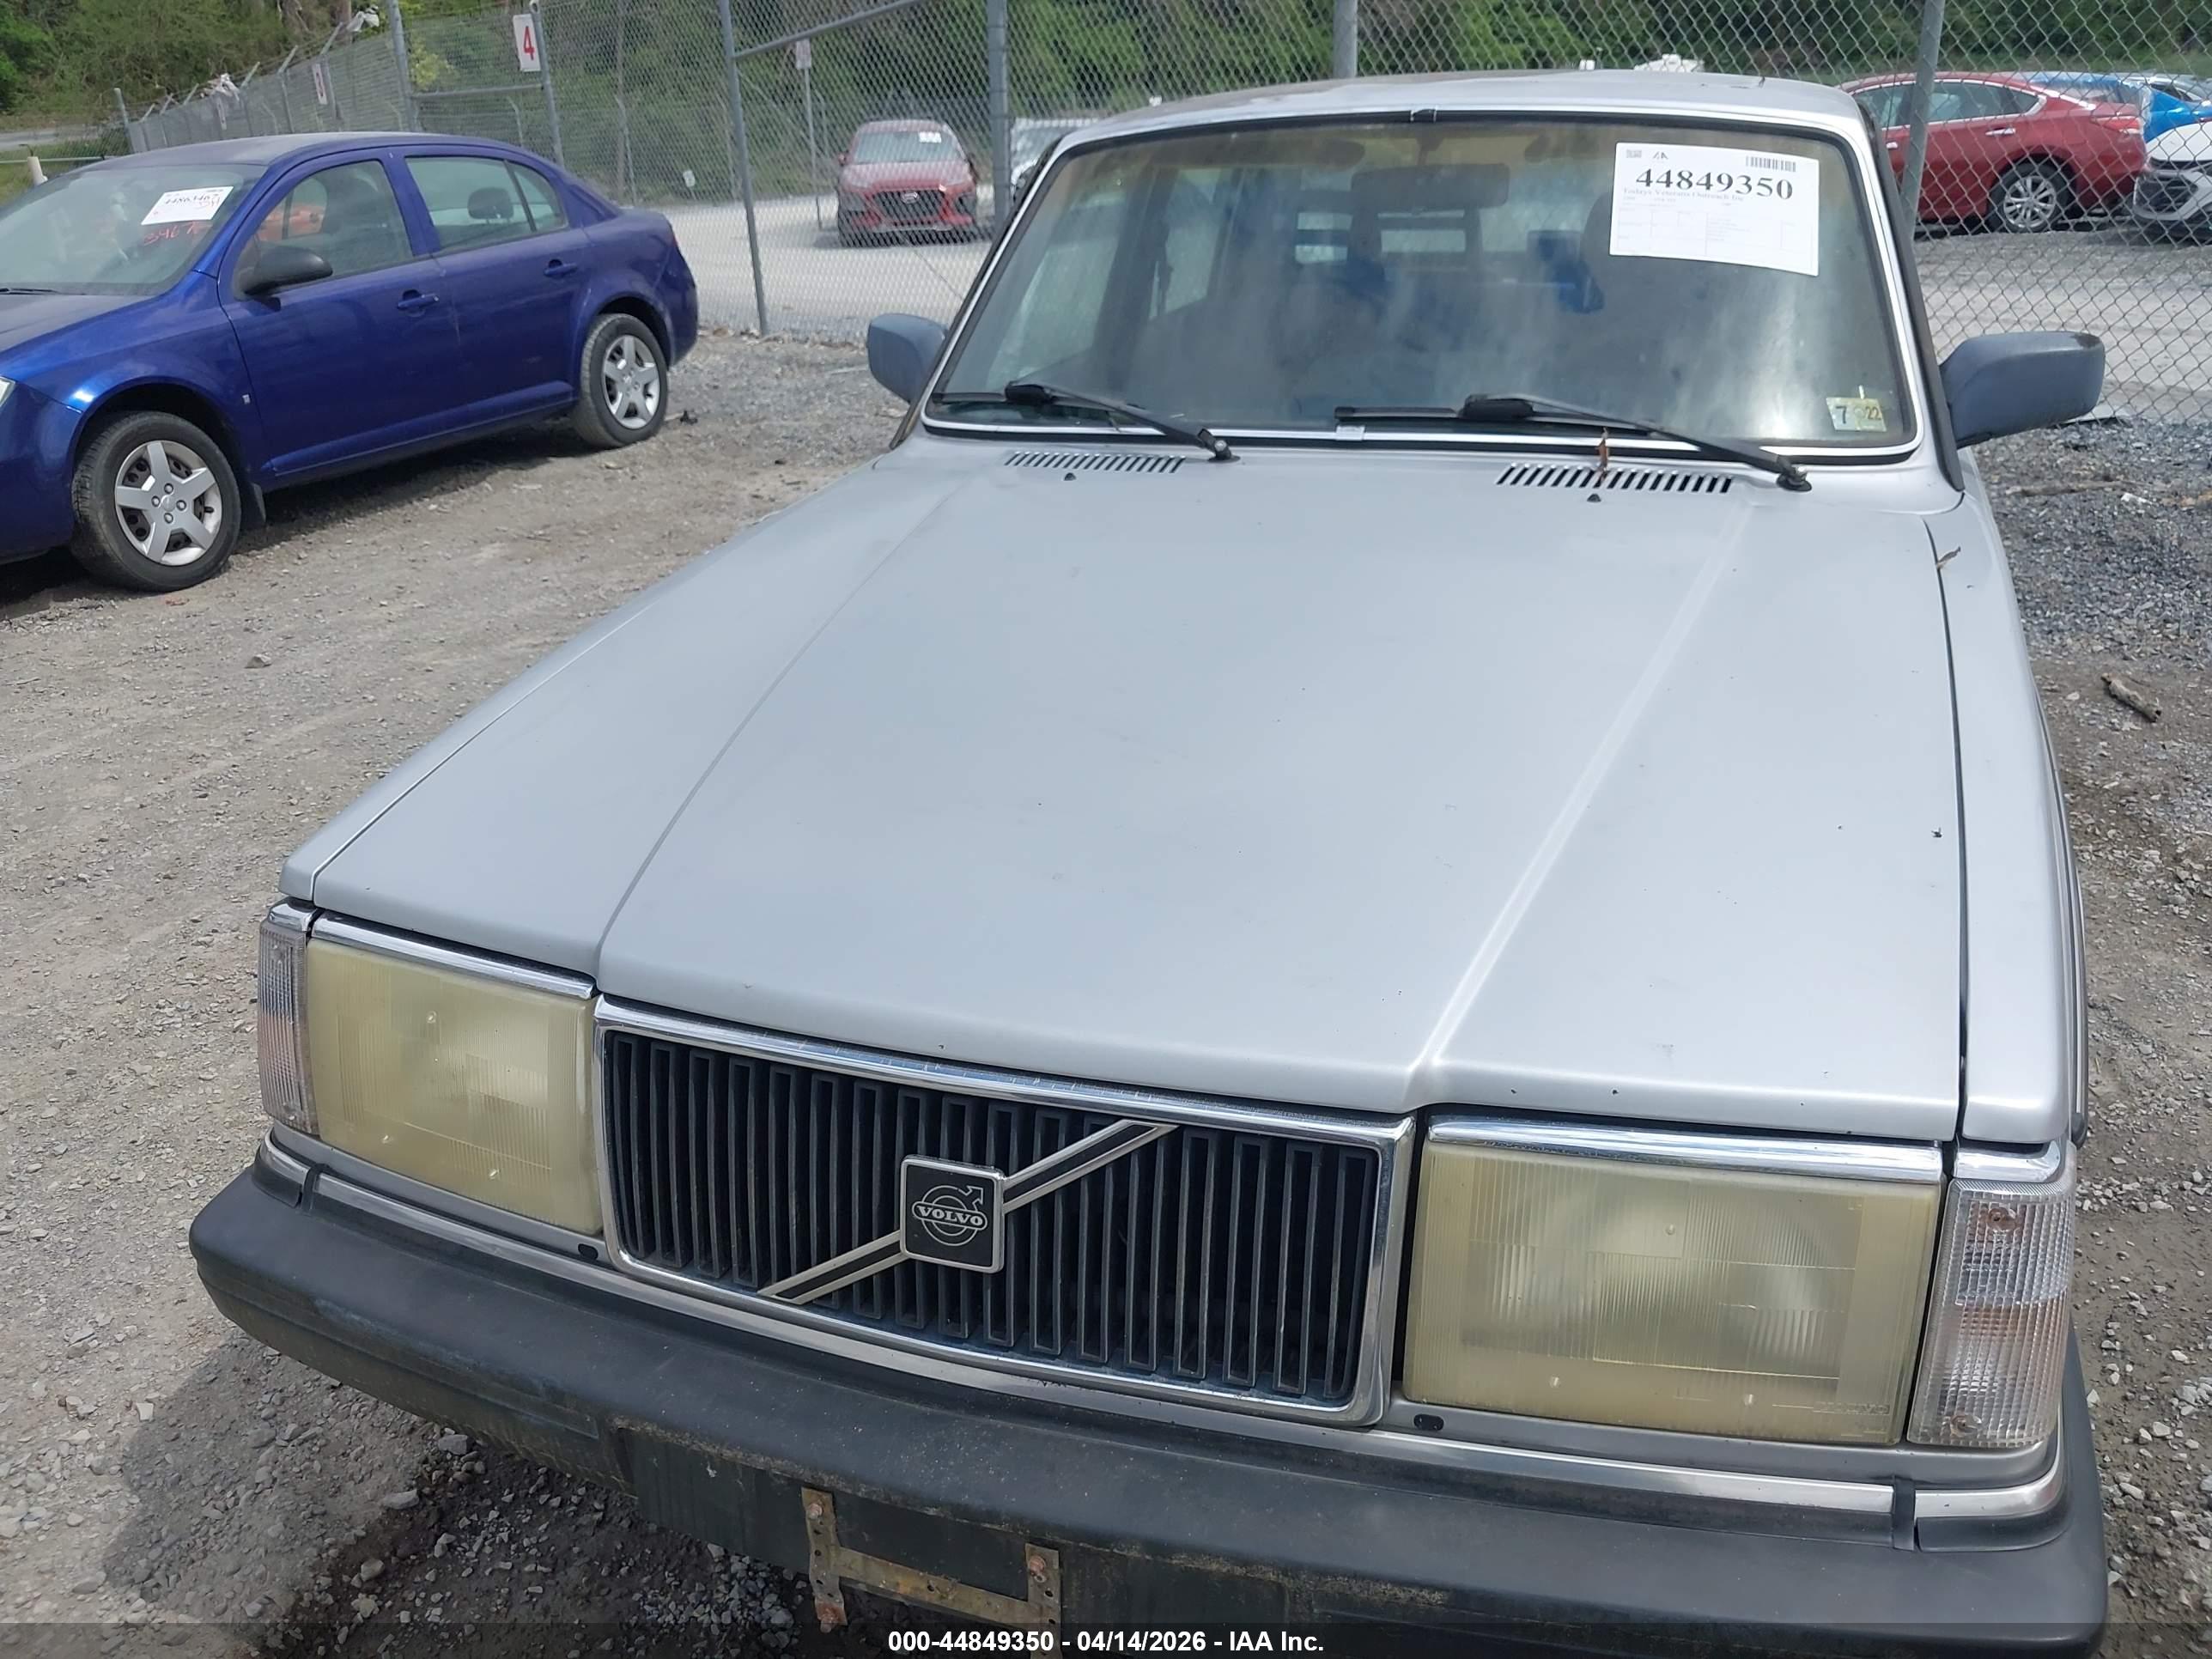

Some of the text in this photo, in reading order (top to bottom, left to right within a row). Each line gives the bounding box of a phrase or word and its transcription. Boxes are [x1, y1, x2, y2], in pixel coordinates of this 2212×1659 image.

[523, 25, 535, 61] 4
[1636, 168, 1793, 200] 44849350
[1835, 405, 1882, 425] 7 22
[916, 1205, 984, 1226] VOLVO
